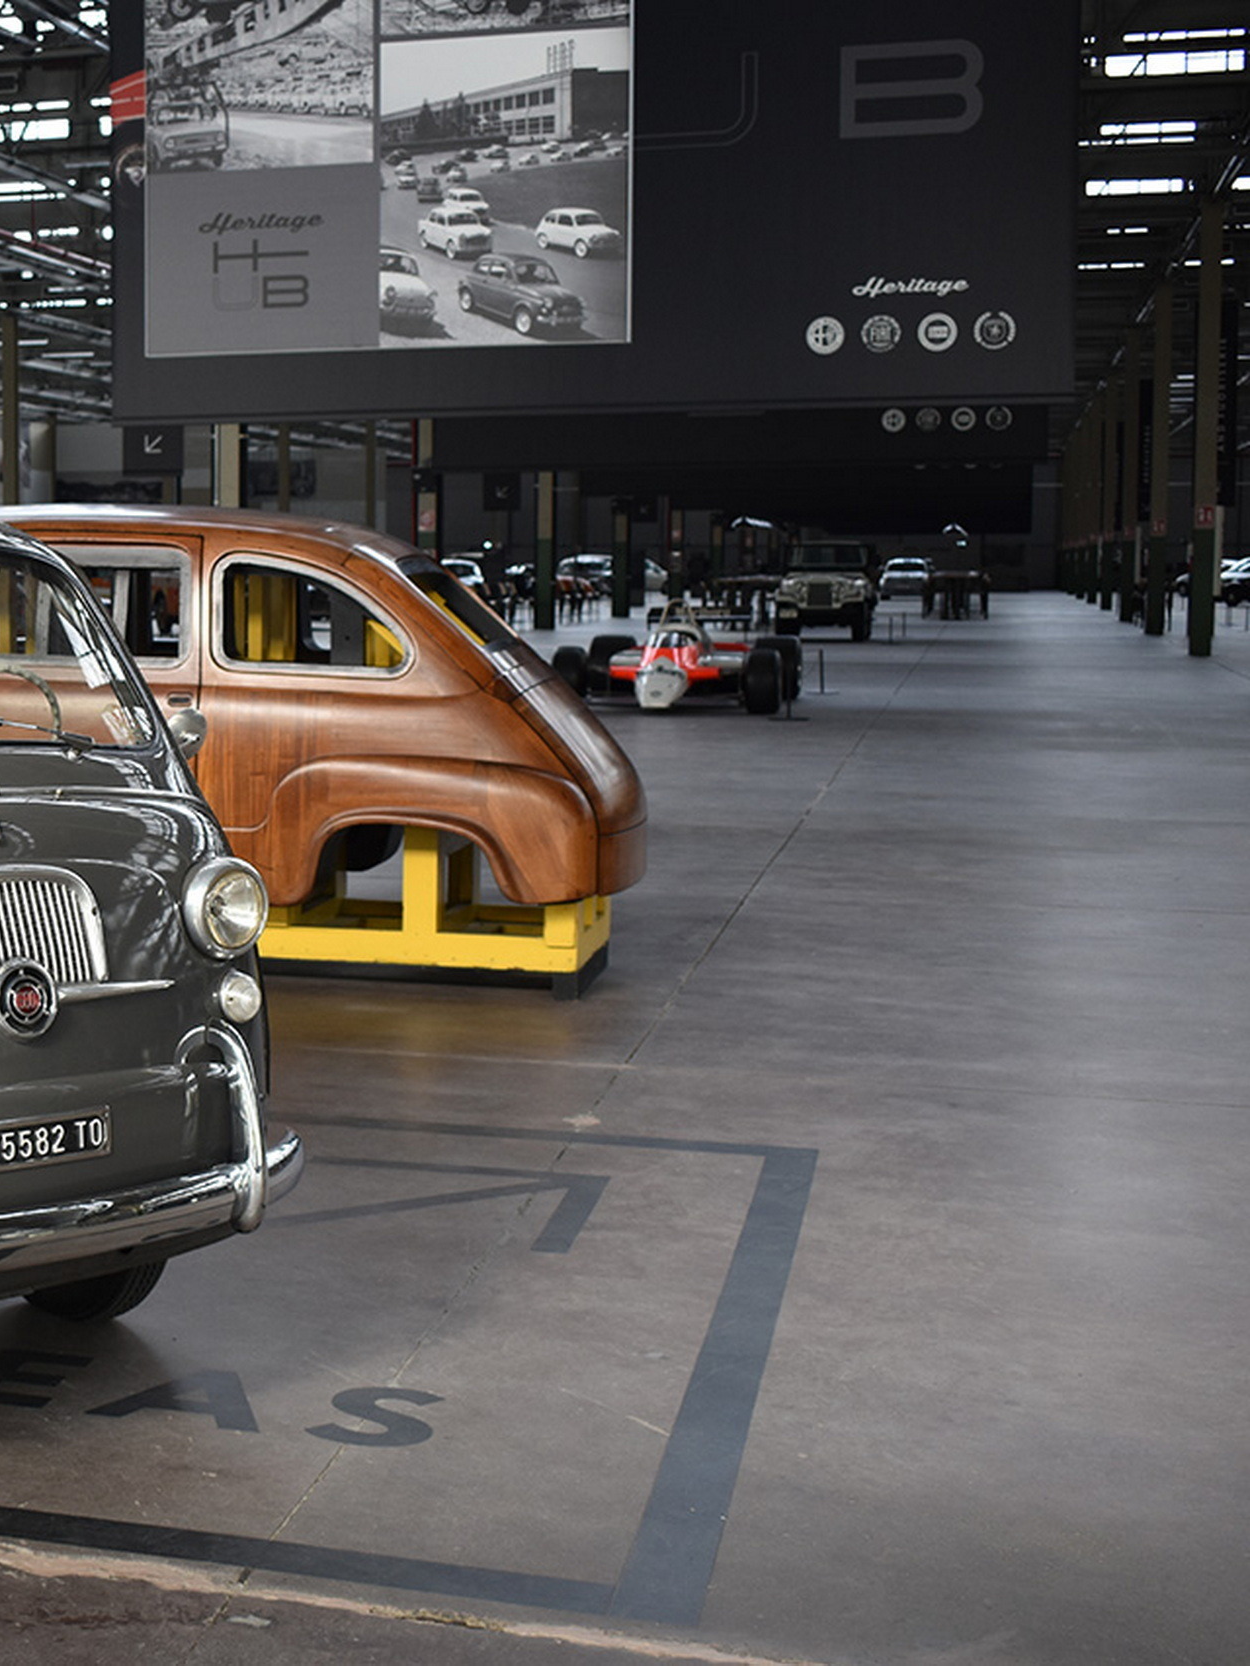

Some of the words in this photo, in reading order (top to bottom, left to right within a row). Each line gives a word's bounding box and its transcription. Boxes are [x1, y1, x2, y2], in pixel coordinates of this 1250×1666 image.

[199, 212, 324, 235] Heritage
[852, 277, 969, 297] Heritage
[74, 1118, 103, 1149] TO
